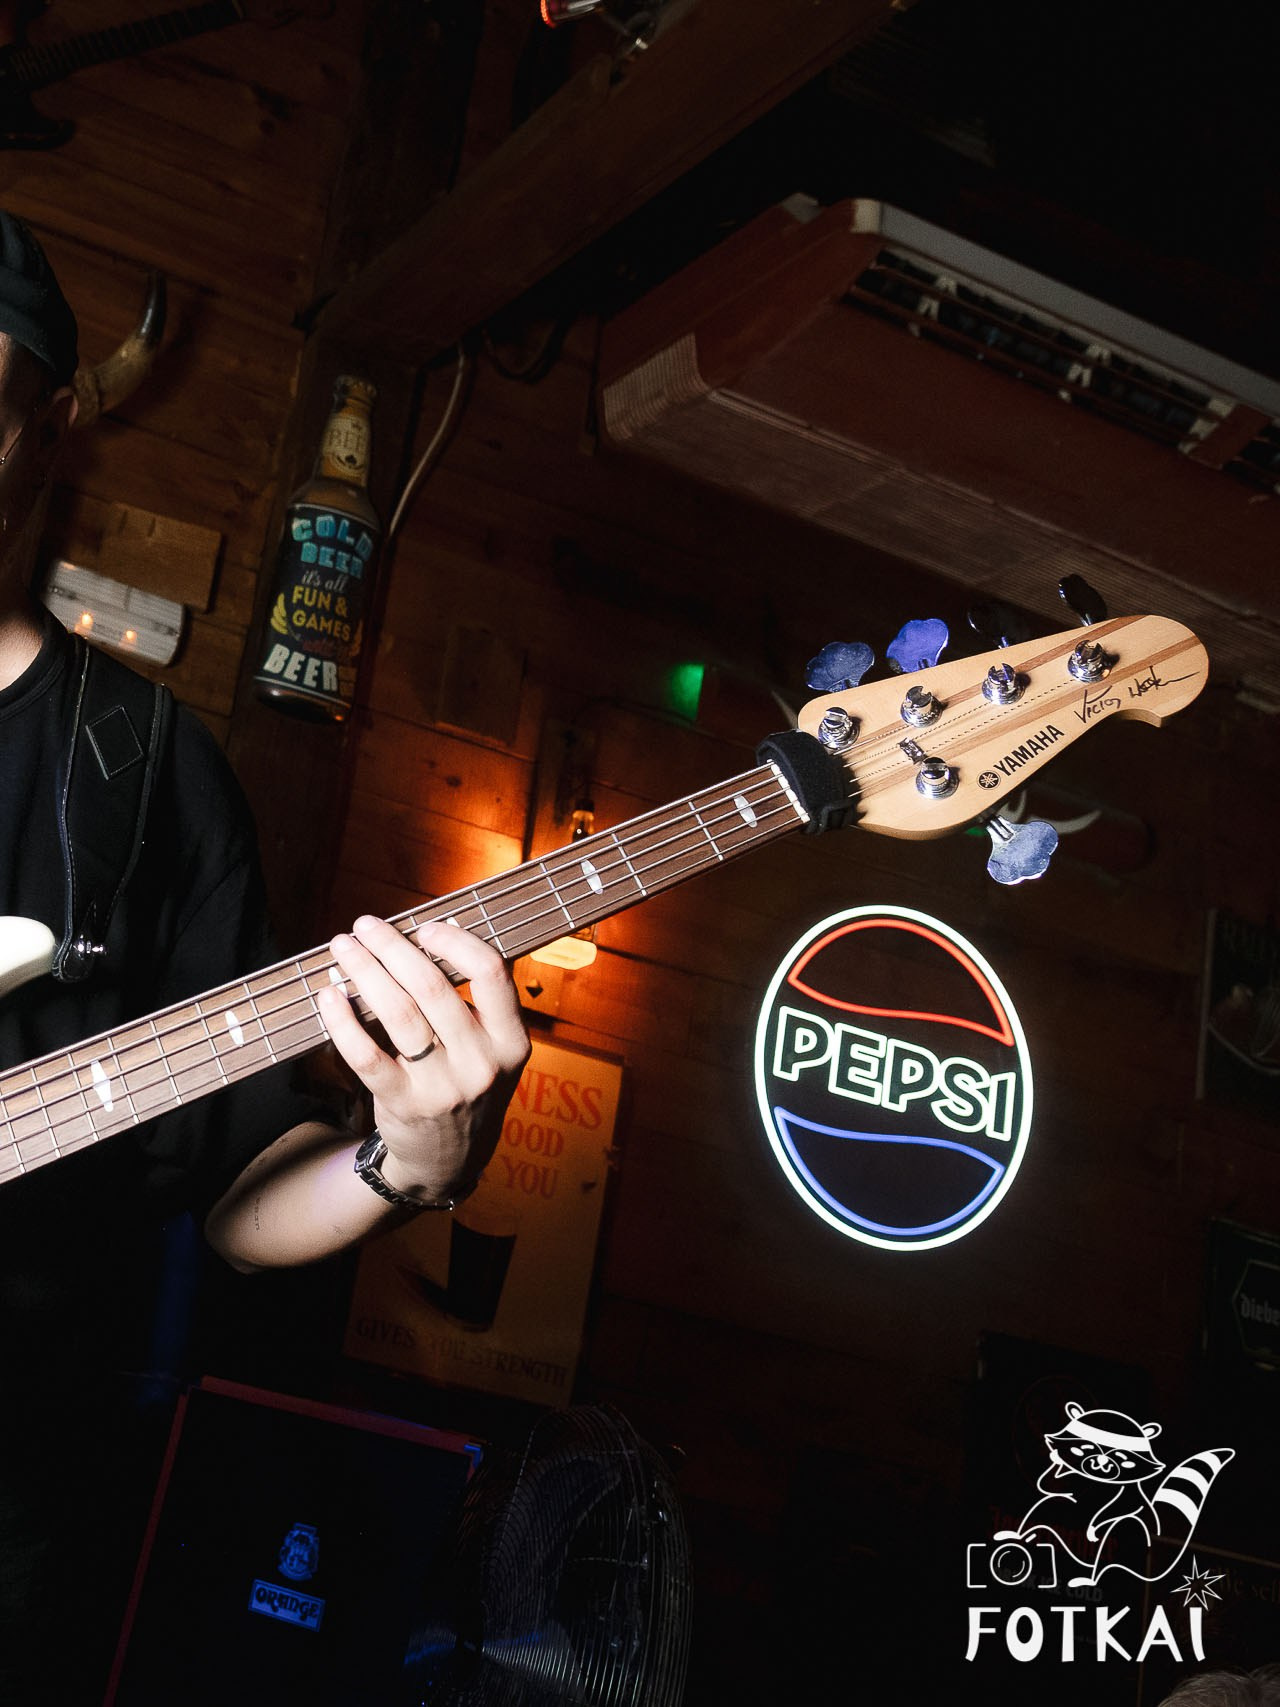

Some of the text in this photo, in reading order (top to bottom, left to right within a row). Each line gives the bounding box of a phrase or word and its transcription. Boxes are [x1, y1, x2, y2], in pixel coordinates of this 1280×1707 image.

[292, 514, 373, 561] COLD
[300, 541, 364, 579] BEER
[301, 569, 350, 594] it's all
[292, 585, 348, 618] FUN &
[292, 609, 352, 642] GAMES
[263, 643, 338, 692] BEER
[993, 724, 1065, 776] YAMAHA
[773, 1005, 1016, 1142] PEPSI
[504, 1117, 564, 1158] OOD
[358, 1318, 416, 1349] GIVES
[471, 1346, 569, 1388] STRENGTH
